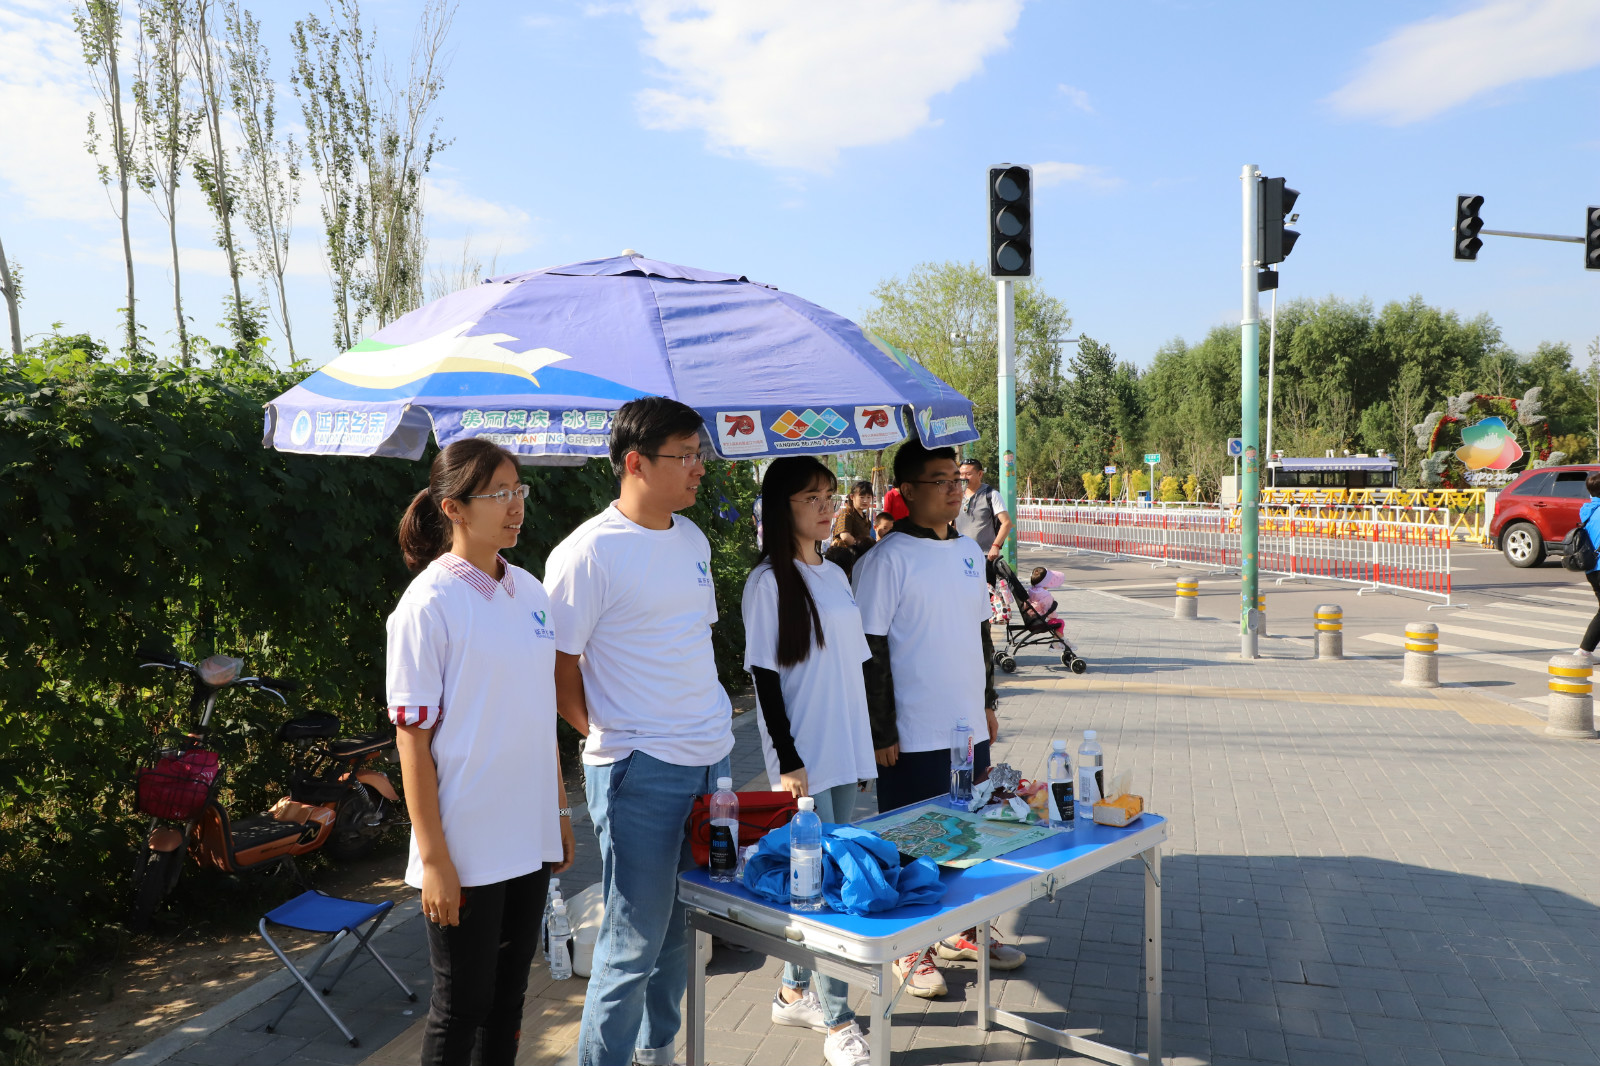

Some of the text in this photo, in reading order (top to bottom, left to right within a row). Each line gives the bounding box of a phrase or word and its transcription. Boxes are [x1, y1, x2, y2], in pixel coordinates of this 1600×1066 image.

[461, 410, 614, 428] 美丽延庆 冰雪
[516, 434, 564, 443] YANQING
[567, 435, 602, 444] GREAT
